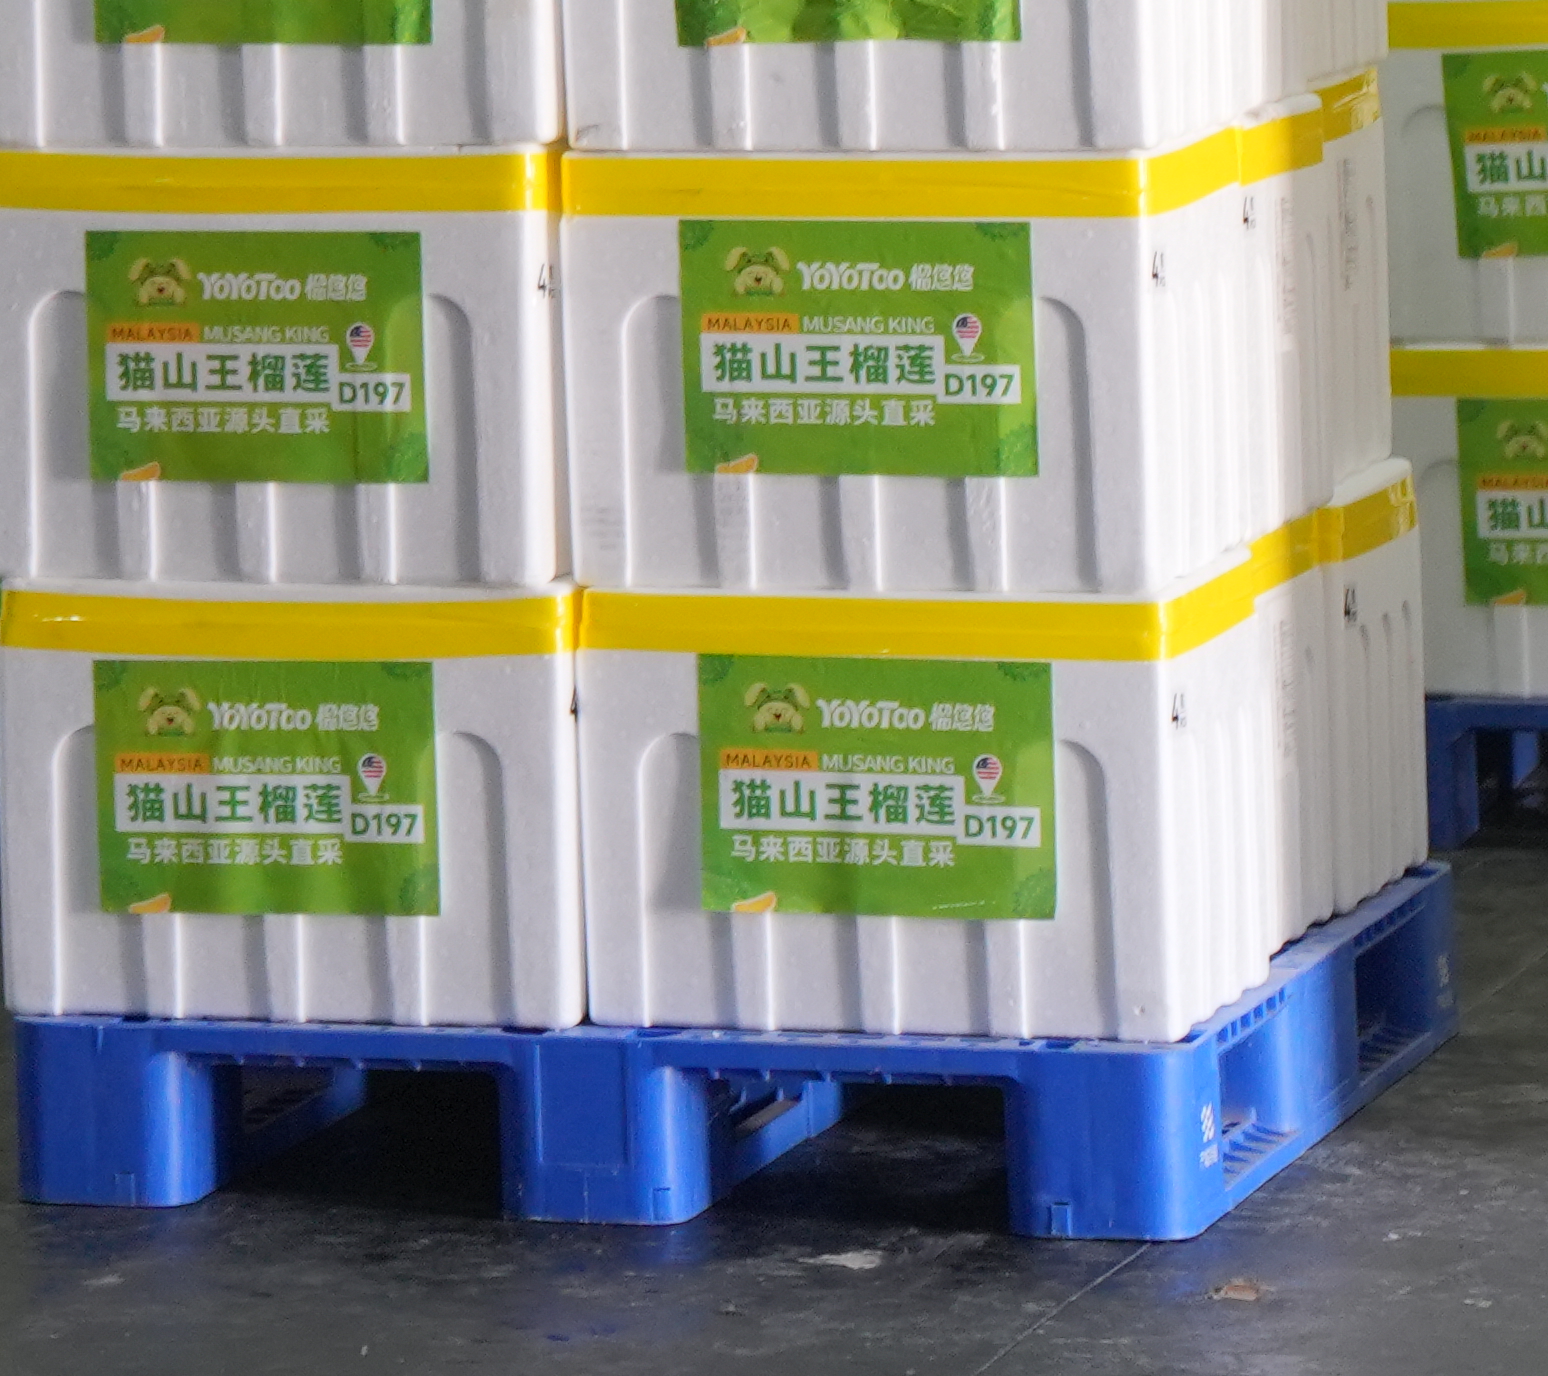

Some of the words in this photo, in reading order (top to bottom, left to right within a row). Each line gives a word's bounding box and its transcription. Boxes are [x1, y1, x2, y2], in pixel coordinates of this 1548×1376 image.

[110, 326, 192, 341] MALAYSIA
[201, 325, 283, 346] MUSANG
[283, 326, 329, 345] KING
[707, 317, 791, 332] MALAYSIA
[803, 316, 884, 336] MUSANG
[887, 317, 935, 336] KING
[118, 352, 330, 393] 猫山王榴莲
[713, 342, 935, 385] 猫山王榴莲
[338, 380, 405, 406] D197
[944, 372, 1014, 397] D197
[116, 406, 333, 434] 马来西亚源头直采
[713, 396, 934, 426] 马来西亚源头直采
[120, 756, 203, 773] MALAYSIA
[213, 756, 293, 776] MUSANG
[294, 757, 341, 776] KING
[724, 753, 810, 769] MALAYSIA
[819, 754, 905, 776] MUSANG
[907, 756, 955, 776] KING
[127, 783, 343, 824] 猫山王榴莲
[732, 779, 955, 825] 猫山王榴莲
[350, 811, 418, 837] D197
[964, 813, 1034, 839] D197
[126, 837, 342, 866] 马来西亚源头直采
[731, 833, 958, 867] 马来西亚源头直采
